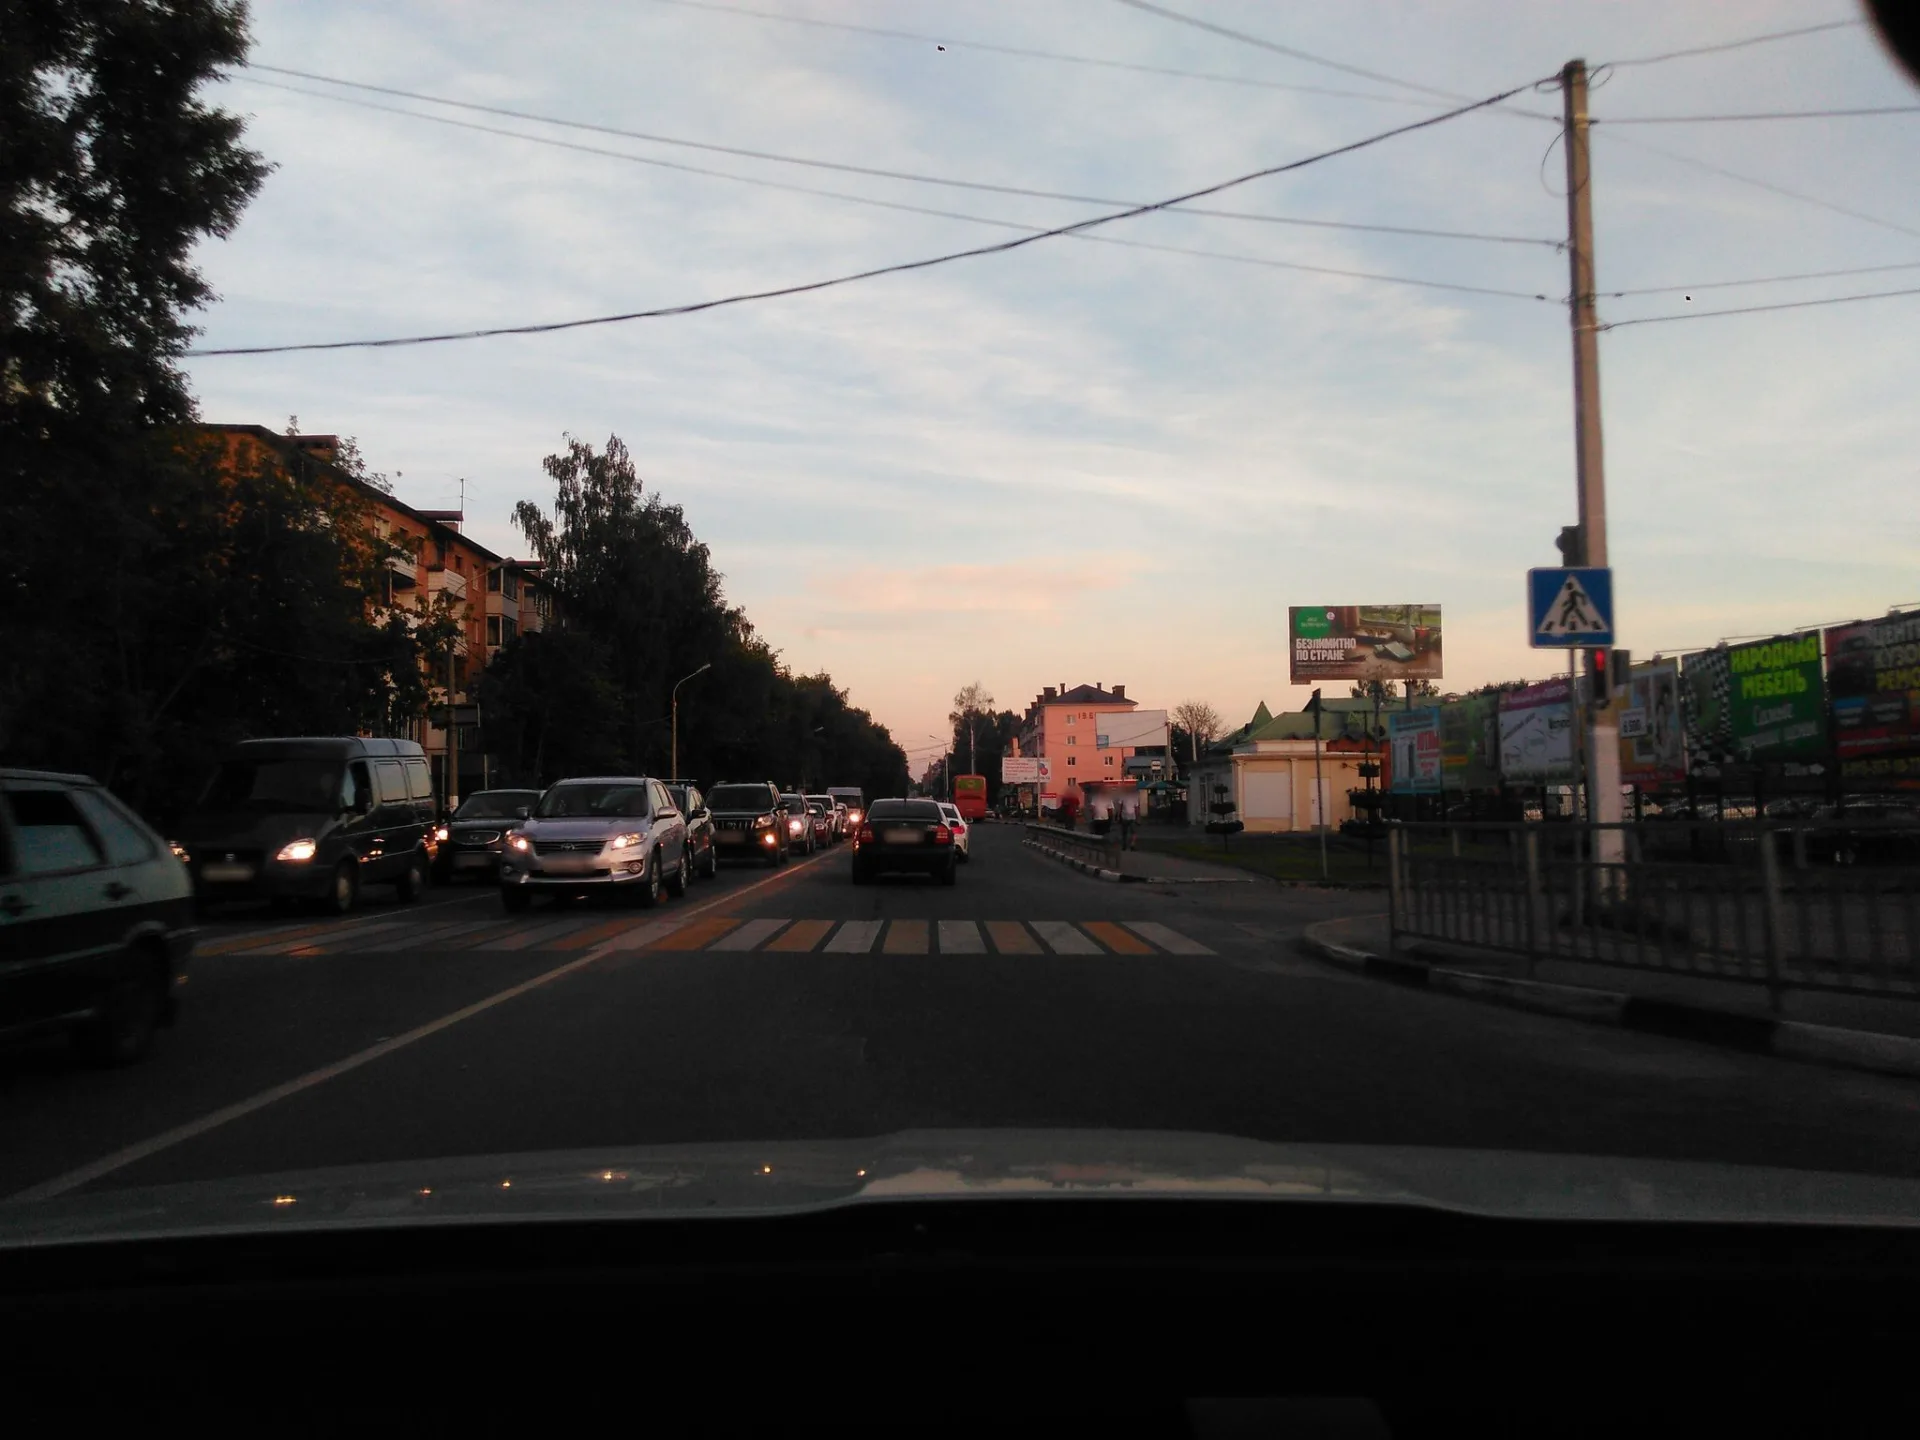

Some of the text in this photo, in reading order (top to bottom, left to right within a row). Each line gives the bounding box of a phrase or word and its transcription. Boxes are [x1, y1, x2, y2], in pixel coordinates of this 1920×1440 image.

[1296, 638, 1357, 649] БЕЗЛИМИТНО
[1296, 650, 1345, 661] ПО СТРАНЕ
[1731, 637, 1817, 673] НАРОДНАЯ
[1875, 643, 1920, 669] КУЗО
[1742, 669, 1808, 699] МЕБЕЛЬ
